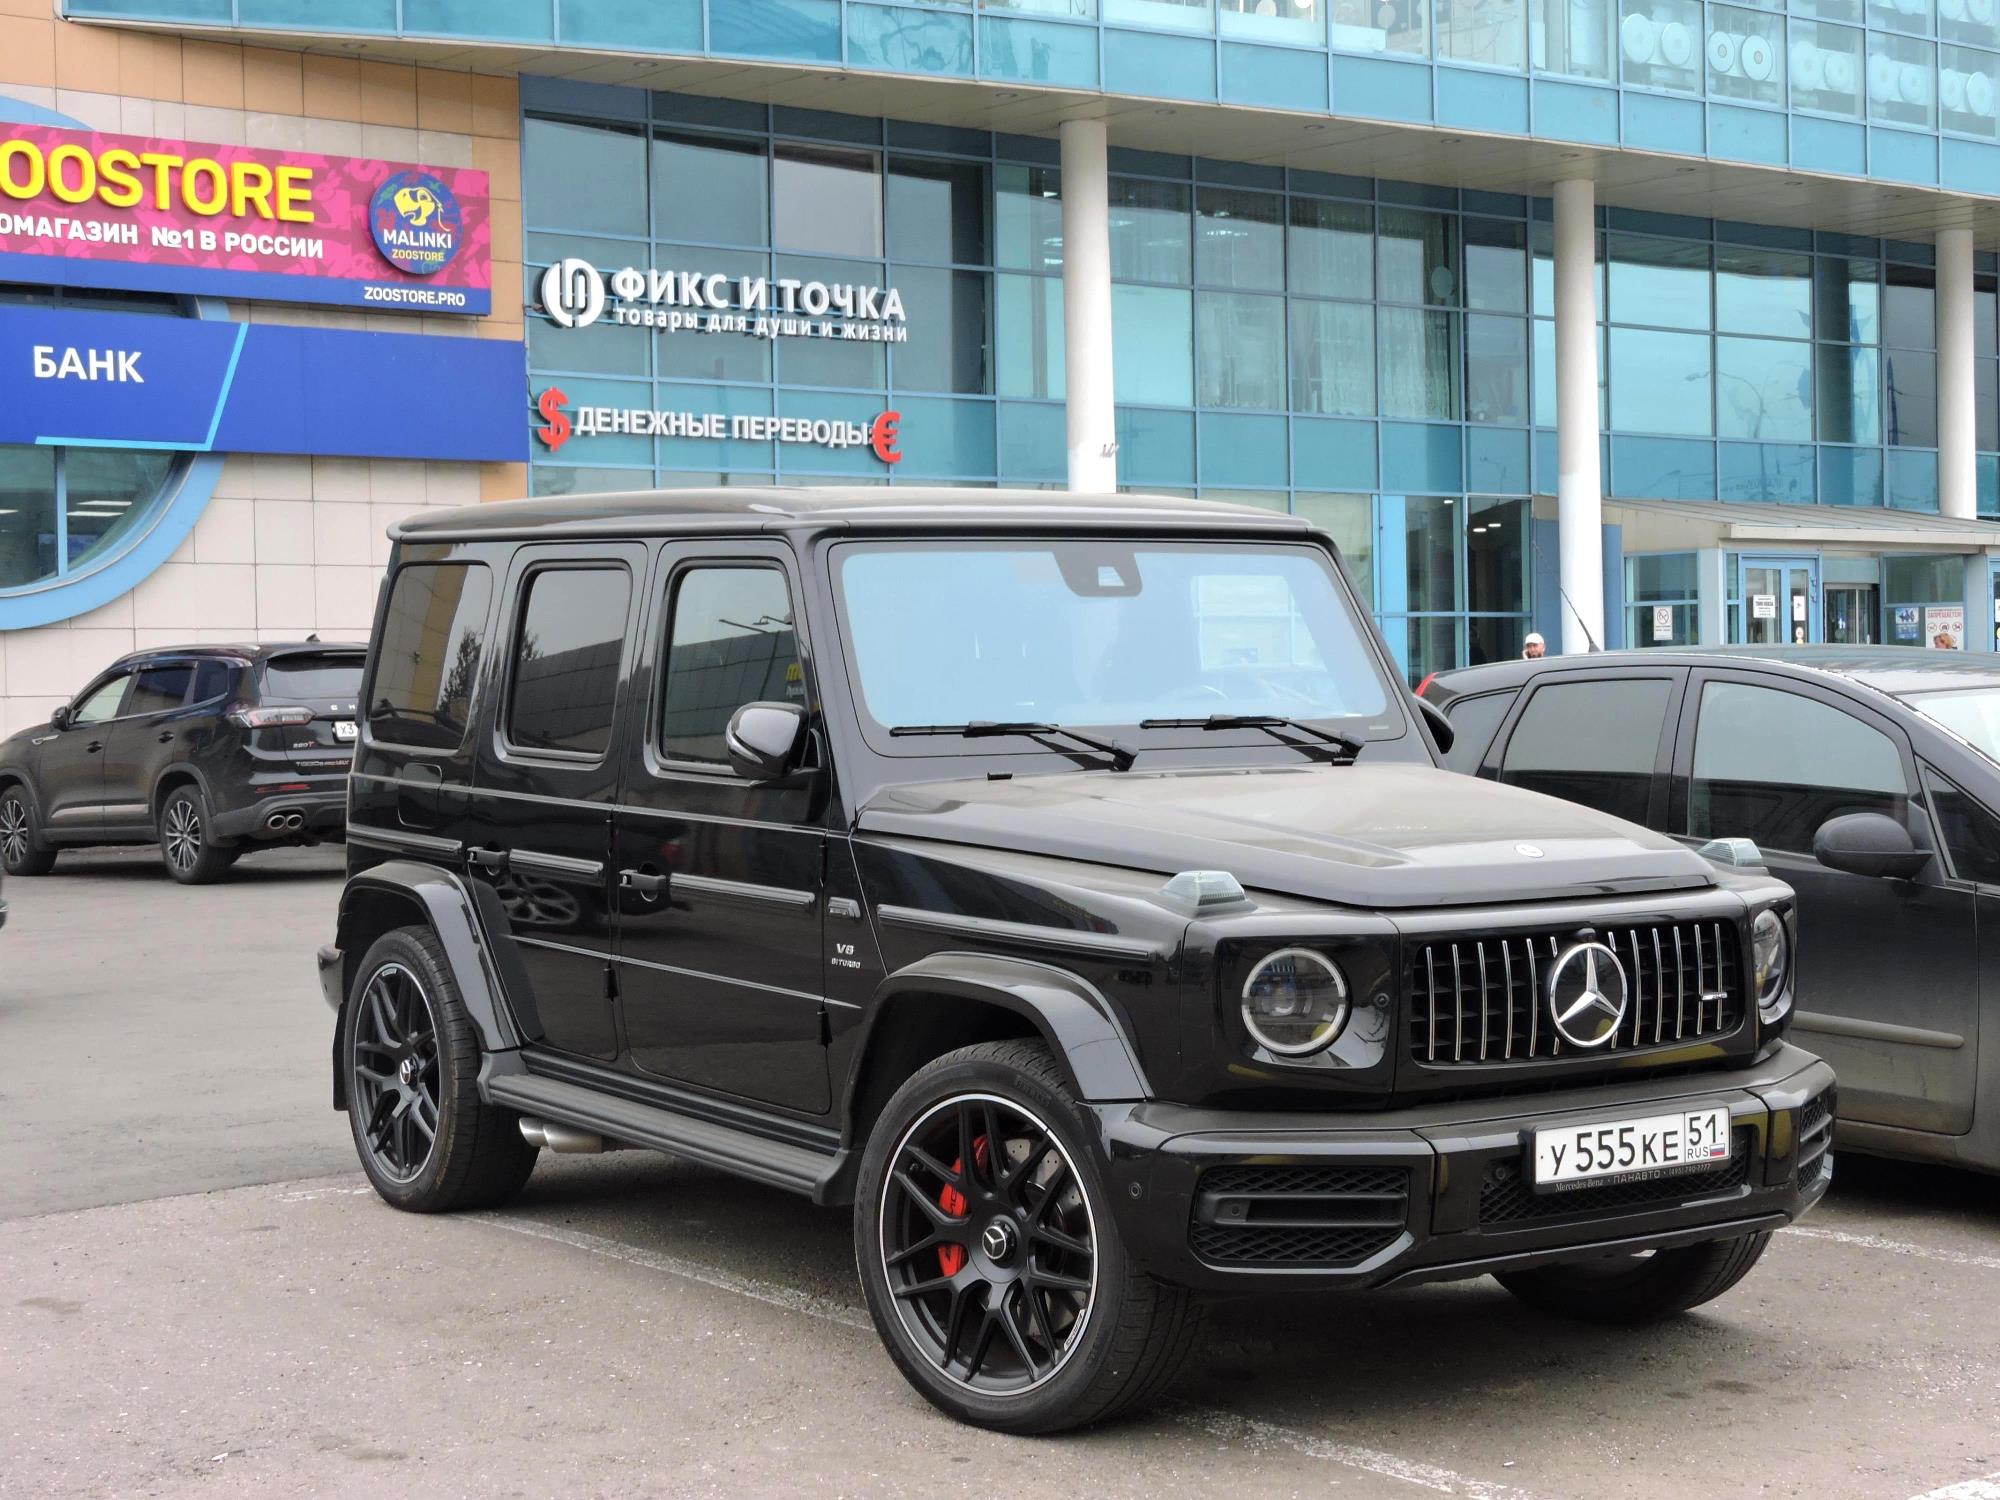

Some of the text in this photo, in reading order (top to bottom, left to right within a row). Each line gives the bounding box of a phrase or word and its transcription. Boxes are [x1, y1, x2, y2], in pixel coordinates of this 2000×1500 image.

[0, 140, 315, 222] OOSTORE
[151, 226, 194, 249] №1
[200, 230, 216, 250] В
[225, 232, 323, 259] РОССИИ
[383, 229, 452, 249] MALINKI
[392, 249, 445, 262] ZOOSTORE
[363, 286, 466, 306] ZOOSTORE.PRO
[611, 266, 906, 322] ФИКС И ТОЧКА
[616, 307, 907, 342] товары для души и жизни
[33, 345, 145, 383] БАНК
[576, 406, 726, 439] ДЕНЕЖНЫЕ
[731, 415, 868, 448] ПЕРЕВОДЫ
[836, 943, 855, 955] V8
[1689, 1114, 1716, 1146] 51
[1687, 1146, 1709, 1159] RUS
[1613, 1169, 1660, 1184] ПАНАВТО
